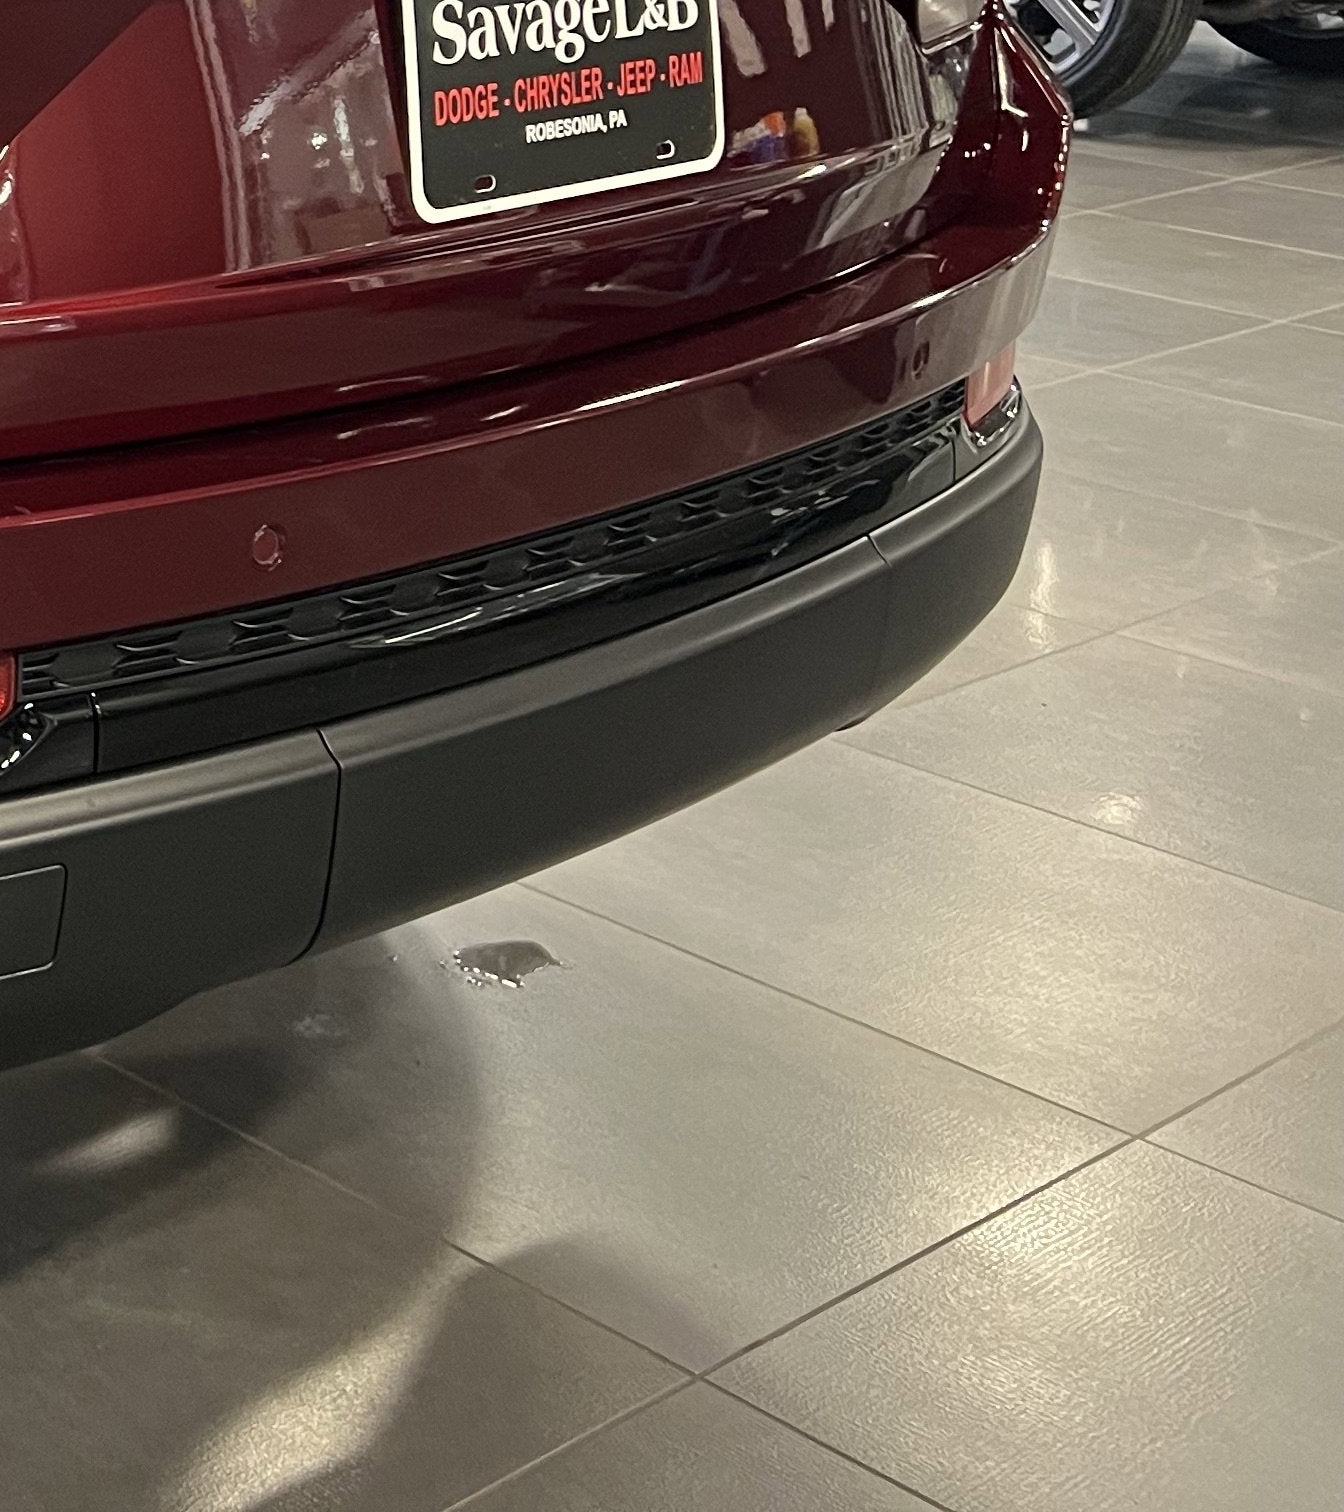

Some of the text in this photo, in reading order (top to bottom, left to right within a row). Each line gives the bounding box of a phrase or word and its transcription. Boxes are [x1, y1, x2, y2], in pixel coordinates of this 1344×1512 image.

[434, 51, 703, 127] DODGE CHRYSLER JEEP RAM
[525, 109, 627, 144] ROBESONIA, PA
